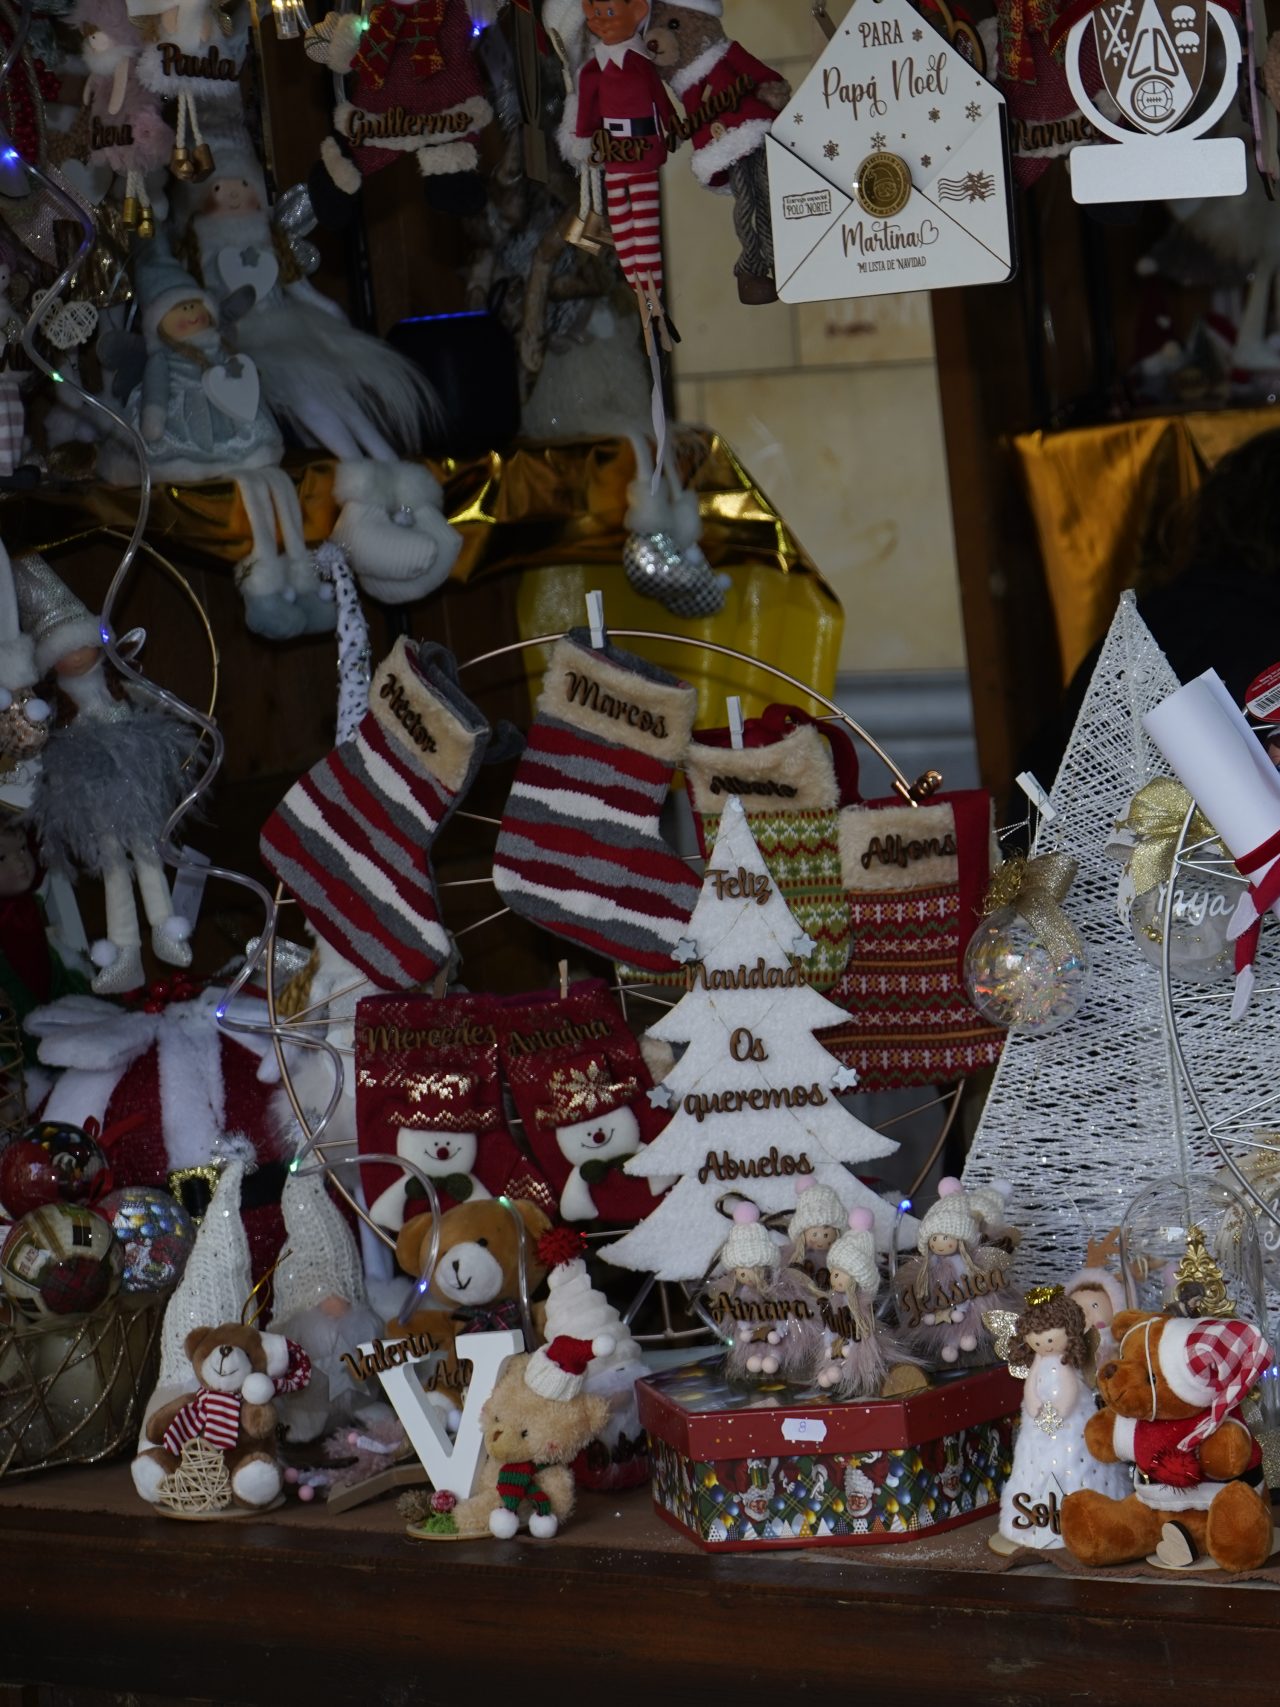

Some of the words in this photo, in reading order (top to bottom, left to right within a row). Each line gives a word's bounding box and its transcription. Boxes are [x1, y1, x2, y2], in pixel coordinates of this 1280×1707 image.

[858, 19, 904, 48] PARA
[157, 42, 240, 82] Paula
[822, 66, 888, 121] Papá
[347, 105, 473, 147] Guillermo
[588, 128, 653, 166] Iker
[805, 201, 828, 214] NORTE
[842, 220, 922, 258] Martina
[857, 262, 868, 274] MI
[868, 260, 886, 273] LISTA
[887, 259, 895, 271] DE
[897, 256, 927, 270] NAVIDAD
[565, 671, 669, 739] Marcos
[704, 866, 773, 905] Feliz
[680, 957, 806, 992] Navidad
[363, 1017, 498, 1051] Mercedes
[507, 1019, 613, 1056] Ariadna
[729, 1027, 769, 1062] Os
[683, 1082, 828, 1122] queremos
[698, 1146, 815, 1184] Abuelos
[902, 1268, 1010, 1328] Jessica
[340, 1332, 439, 1381] Valeria
[1012, 1491, 1061, 1535] Sof
